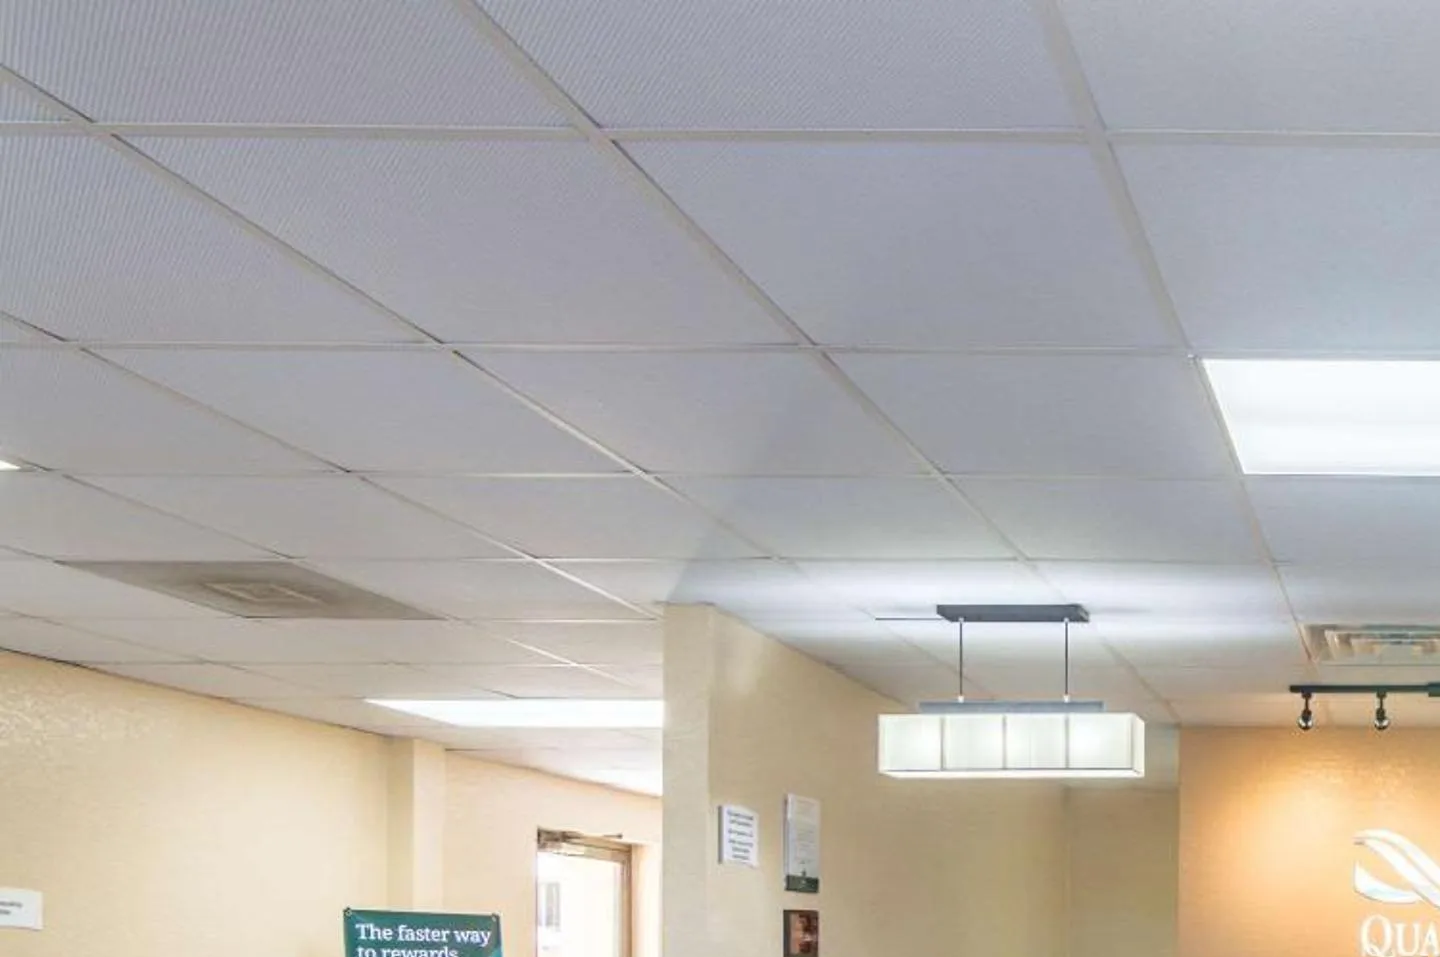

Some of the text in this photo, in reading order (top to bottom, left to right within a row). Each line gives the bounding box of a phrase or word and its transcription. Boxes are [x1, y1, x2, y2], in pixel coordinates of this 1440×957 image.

[355, 922, 492, 948] The faster way
